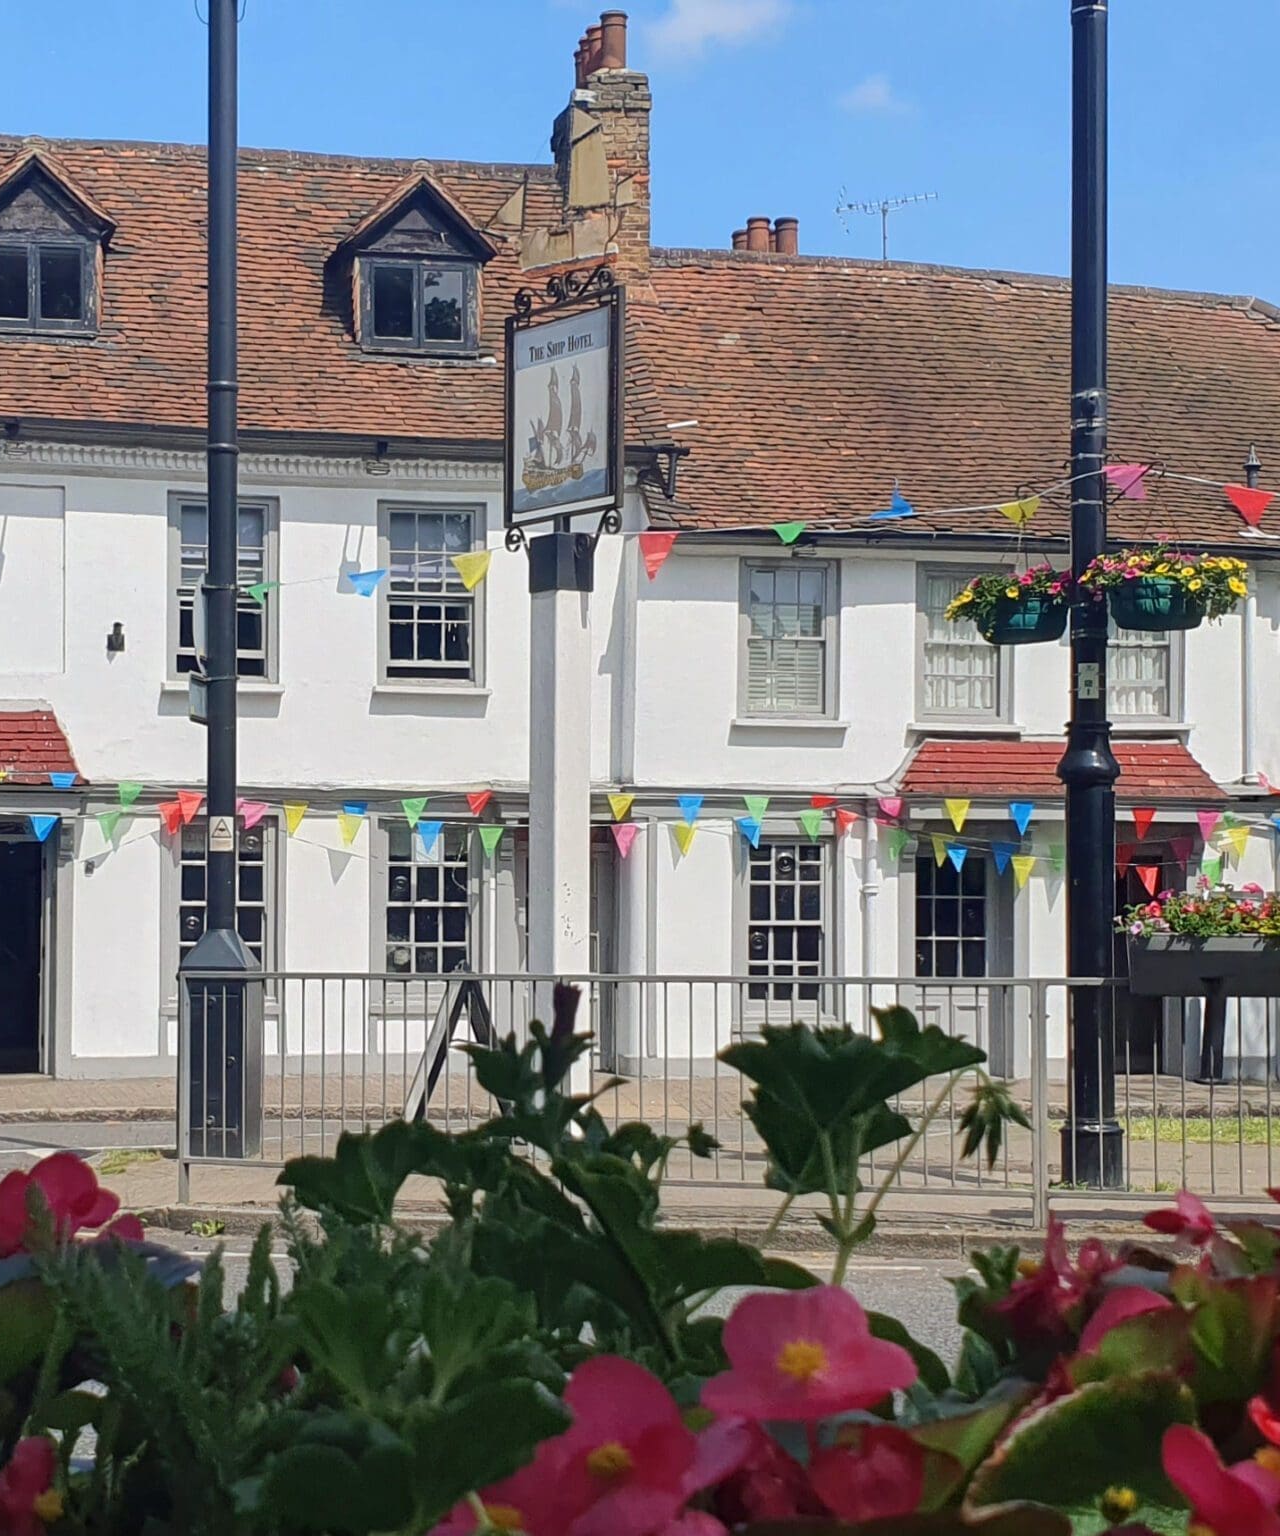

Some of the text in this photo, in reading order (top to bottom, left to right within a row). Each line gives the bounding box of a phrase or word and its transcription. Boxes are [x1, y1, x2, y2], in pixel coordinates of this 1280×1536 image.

[529, 333, 593, 362] THE SHIP HOTEL
